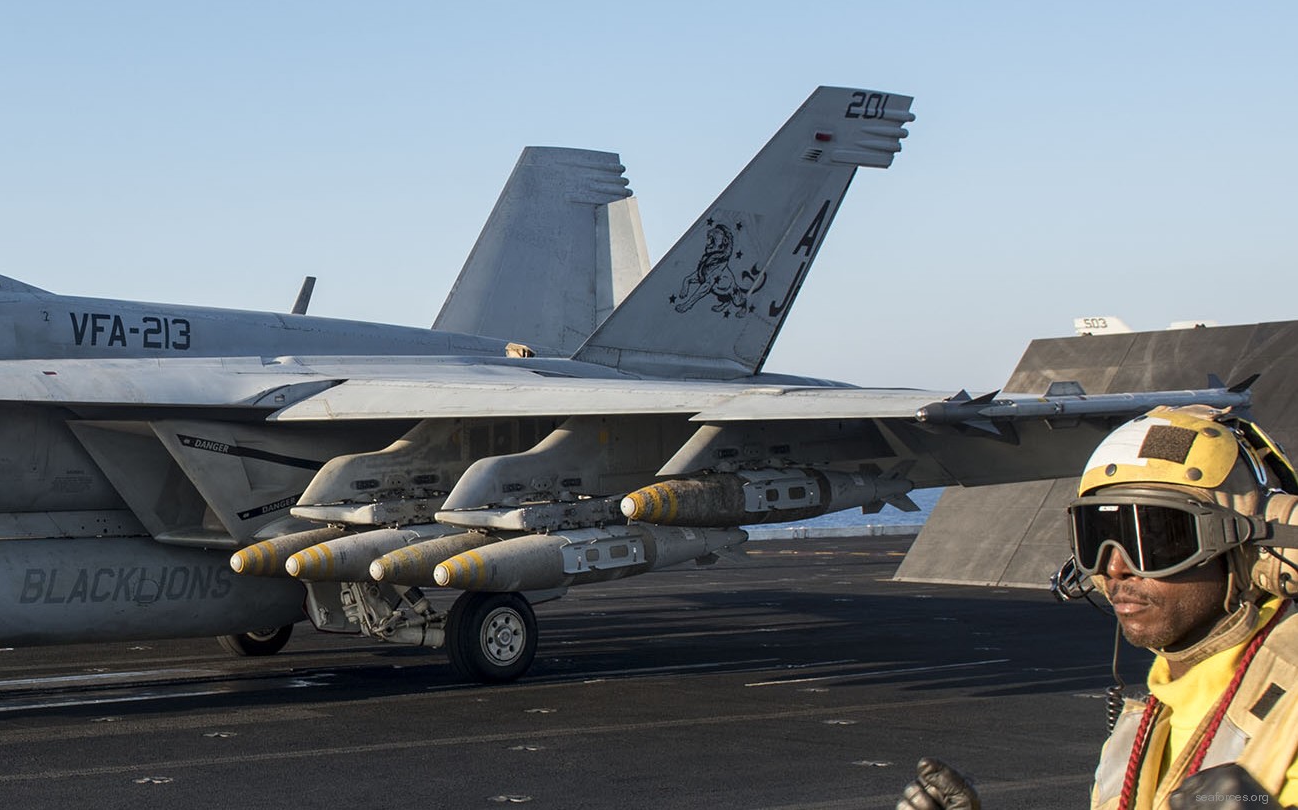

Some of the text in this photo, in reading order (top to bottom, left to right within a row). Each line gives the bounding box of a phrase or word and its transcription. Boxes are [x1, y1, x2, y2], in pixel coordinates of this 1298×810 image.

[845, 91, 890, 120] 201
[69, 311, 191, 350] VFA-213
[1083, 318, 1108, 329] 503
[194, 439, 230, 454] DANGER
[262, 497, 296, 514] DANGER
